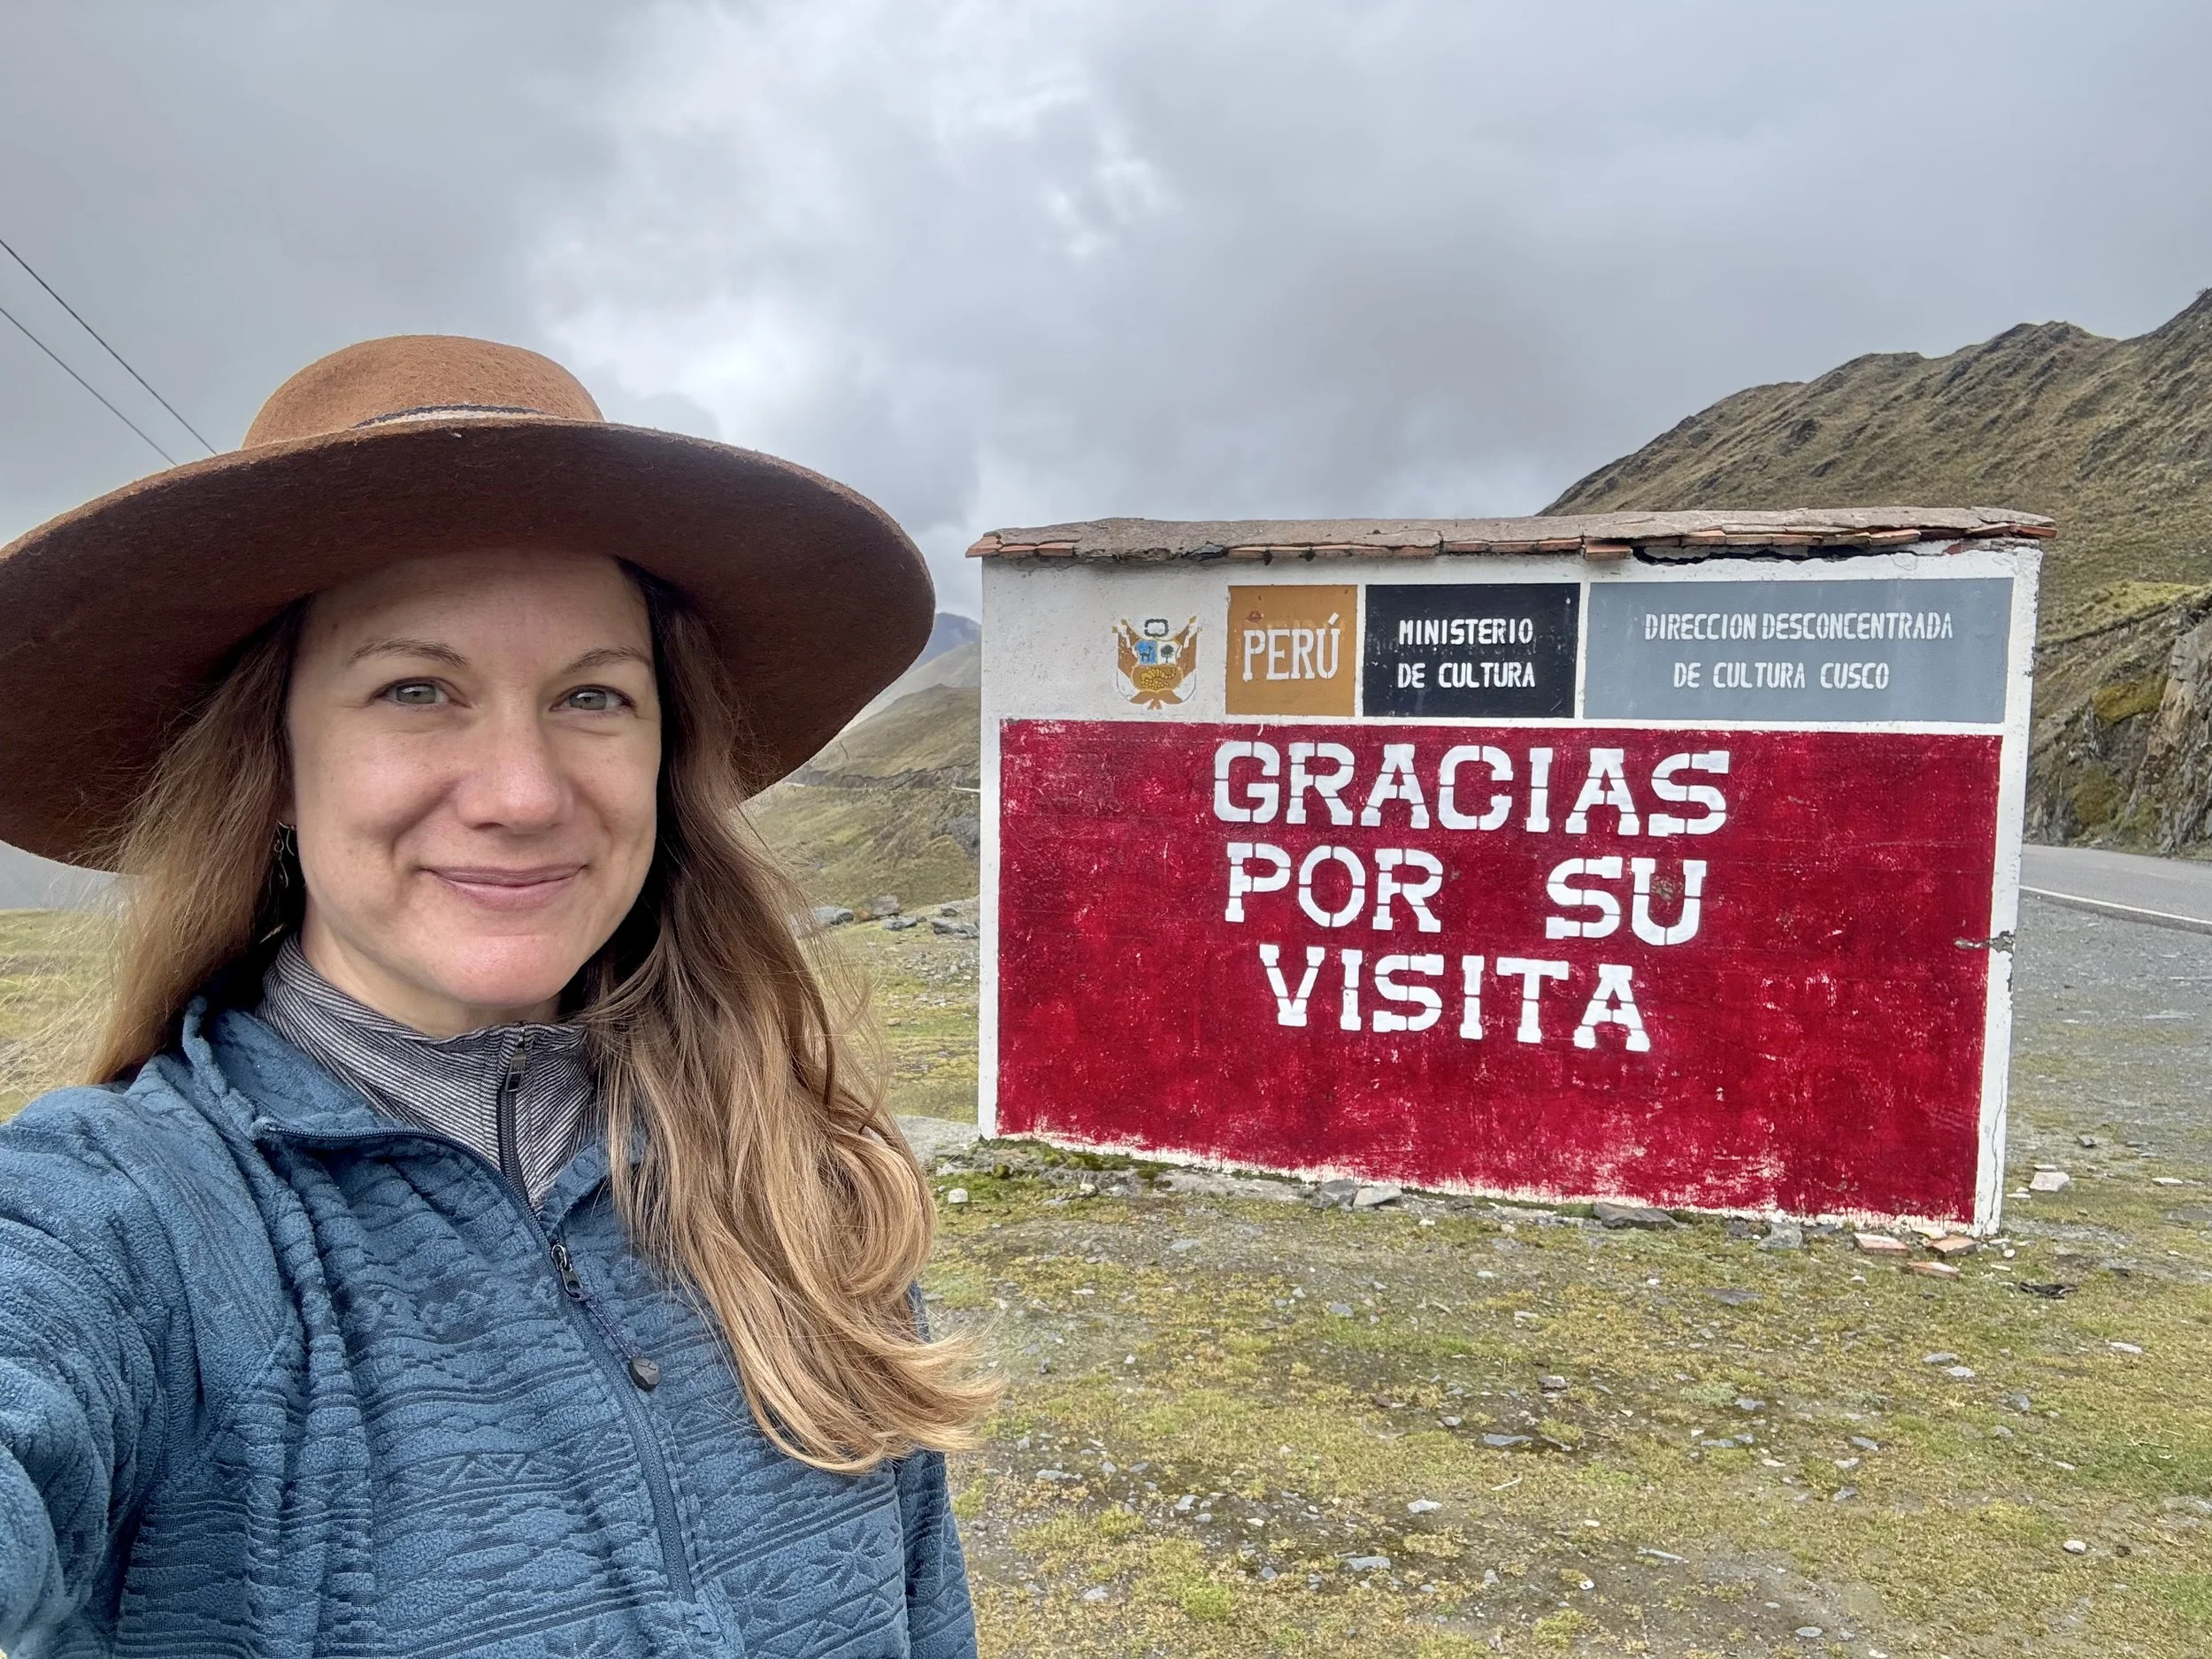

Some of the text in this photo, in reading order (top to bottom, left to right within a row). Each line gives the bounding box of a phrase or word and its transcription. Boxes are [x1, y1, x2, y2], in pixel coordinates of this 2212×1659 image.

[1241, 612, 1340, 682] PERÚ
[1398, 618, 1534, 645] MINISTERIO
[1644, 611, 1955, 641] DIRECCION DESCONCENTRADA
[1397, 662, 1536, 688] DE CULTURA
[1673, 662, 1890, 689] DE CULTURA CUSCO
[1213, 741, 1730, 837] GRACIAS
[1225, 842, 1708, 946] POR SU
[1259, 943, 1651, 1052] VISITA
